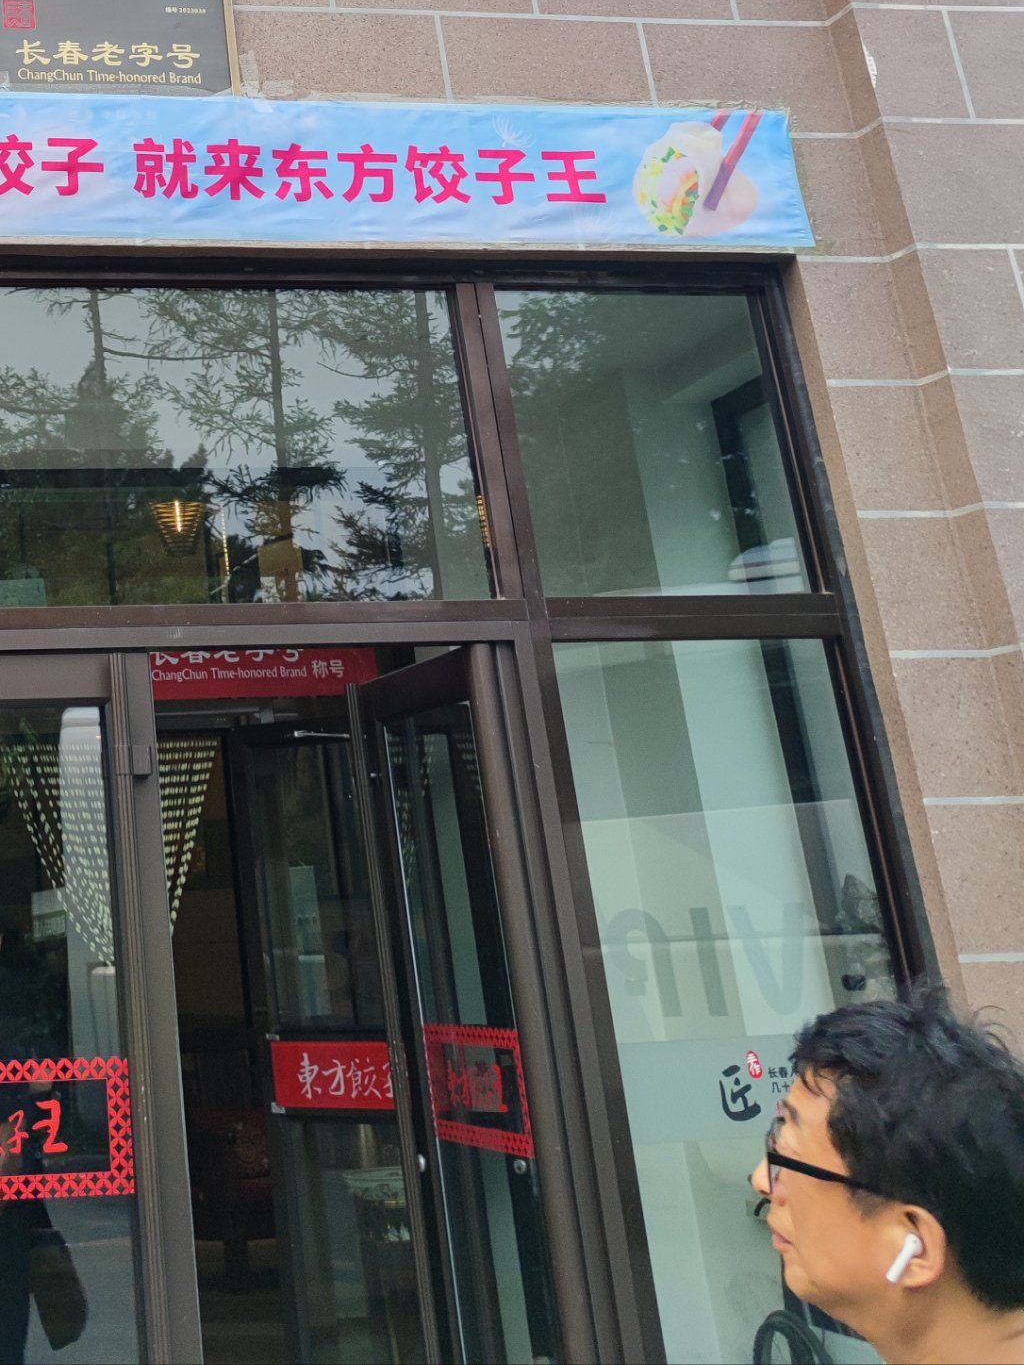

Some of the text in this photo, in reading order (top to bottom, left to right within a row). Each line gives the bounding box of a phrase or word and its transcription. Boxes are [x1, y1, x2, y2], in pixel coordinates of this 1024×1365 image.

[15, 38, 201, 70] 长春老字号
[17, 67, 202, 84] ChangChun Time-honored Brand
[133, 136, 607, 206] 就来东方饺子王
[151, 669, 208, 683] ChangChun
[280, 666, 307, 678] Brand
[311, 659, 345, 679] 称号
[719, 1064, 762, 1122] 匠
